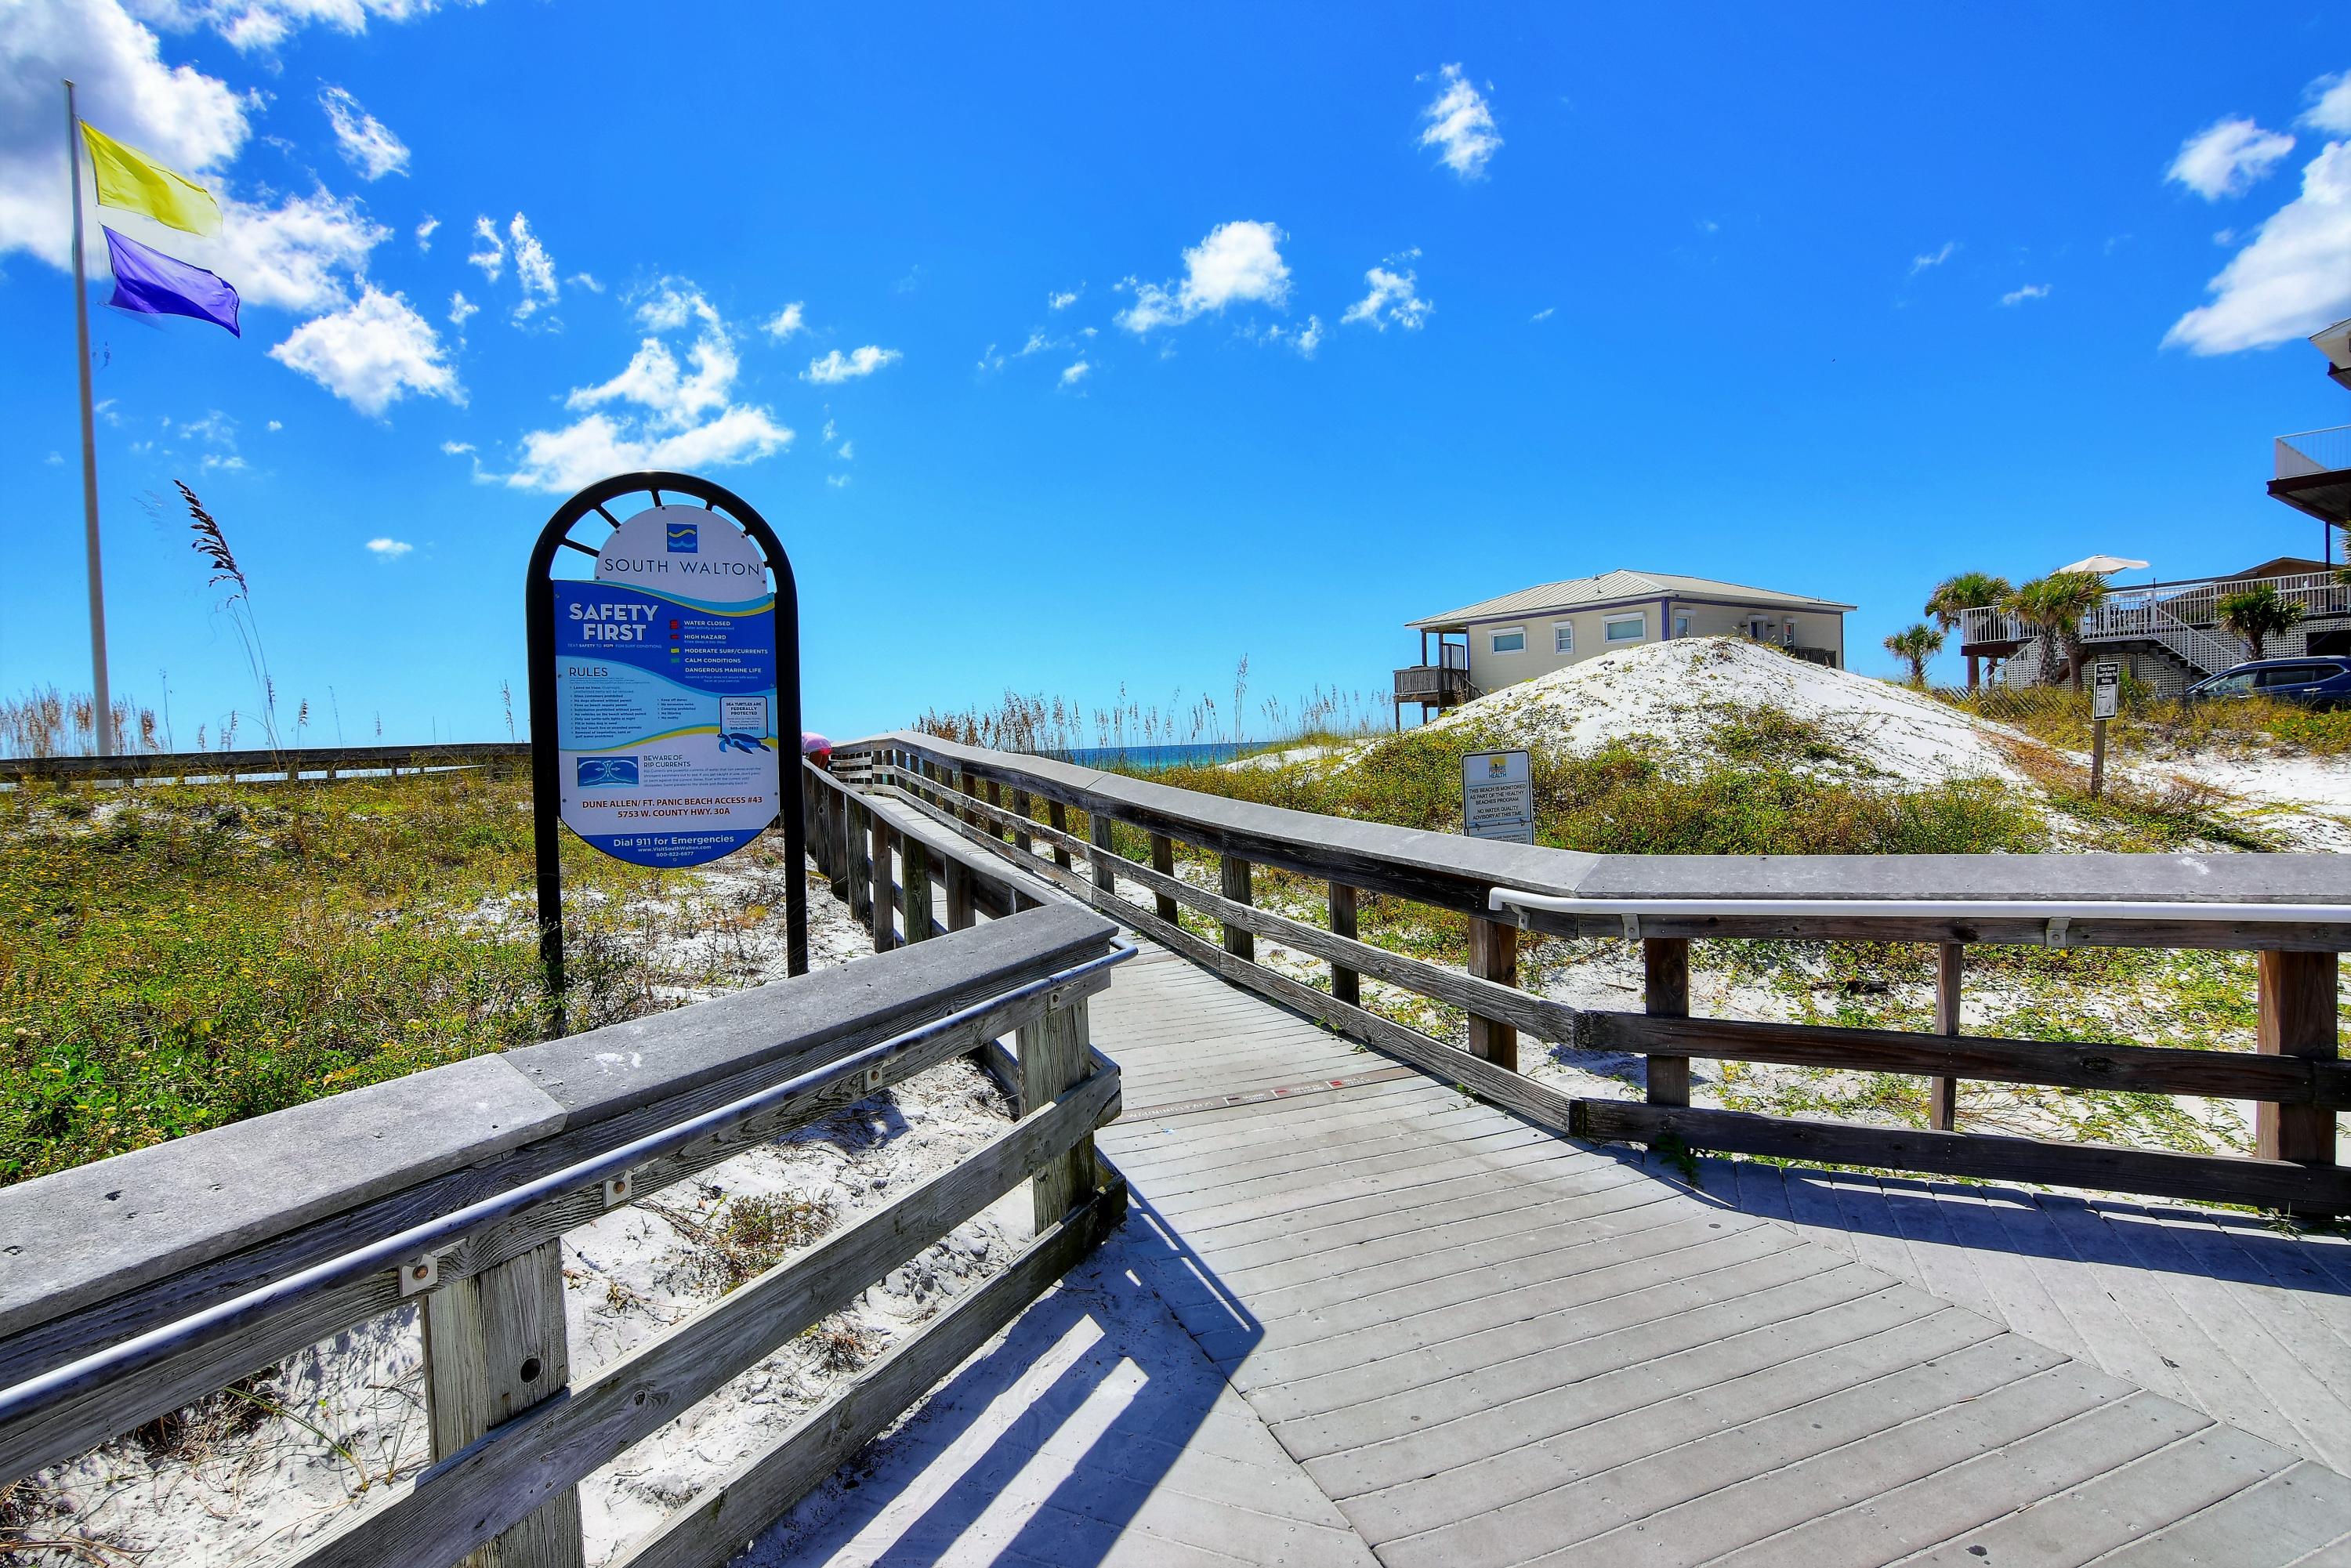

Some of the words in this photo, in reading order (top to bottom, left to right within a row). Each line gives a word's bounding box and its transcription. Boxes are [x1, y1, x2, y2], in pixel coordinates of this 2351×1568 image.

[604, 558, 668, 573] SOUTH
[679, 561, 760, 576] WALTON
[569, 603, 658, 621] SAFETY
[583, 623, 647, 641] FIRST
[569, 667, 608, 677] RULES
[610, 799, 641, 808] ALLEN/
[614, 838, 633, 847] Dial
[636, 838, 650, 846] 911
[654, 837, 668, 846] for
[672, 835, 734, 846] Emergencies
